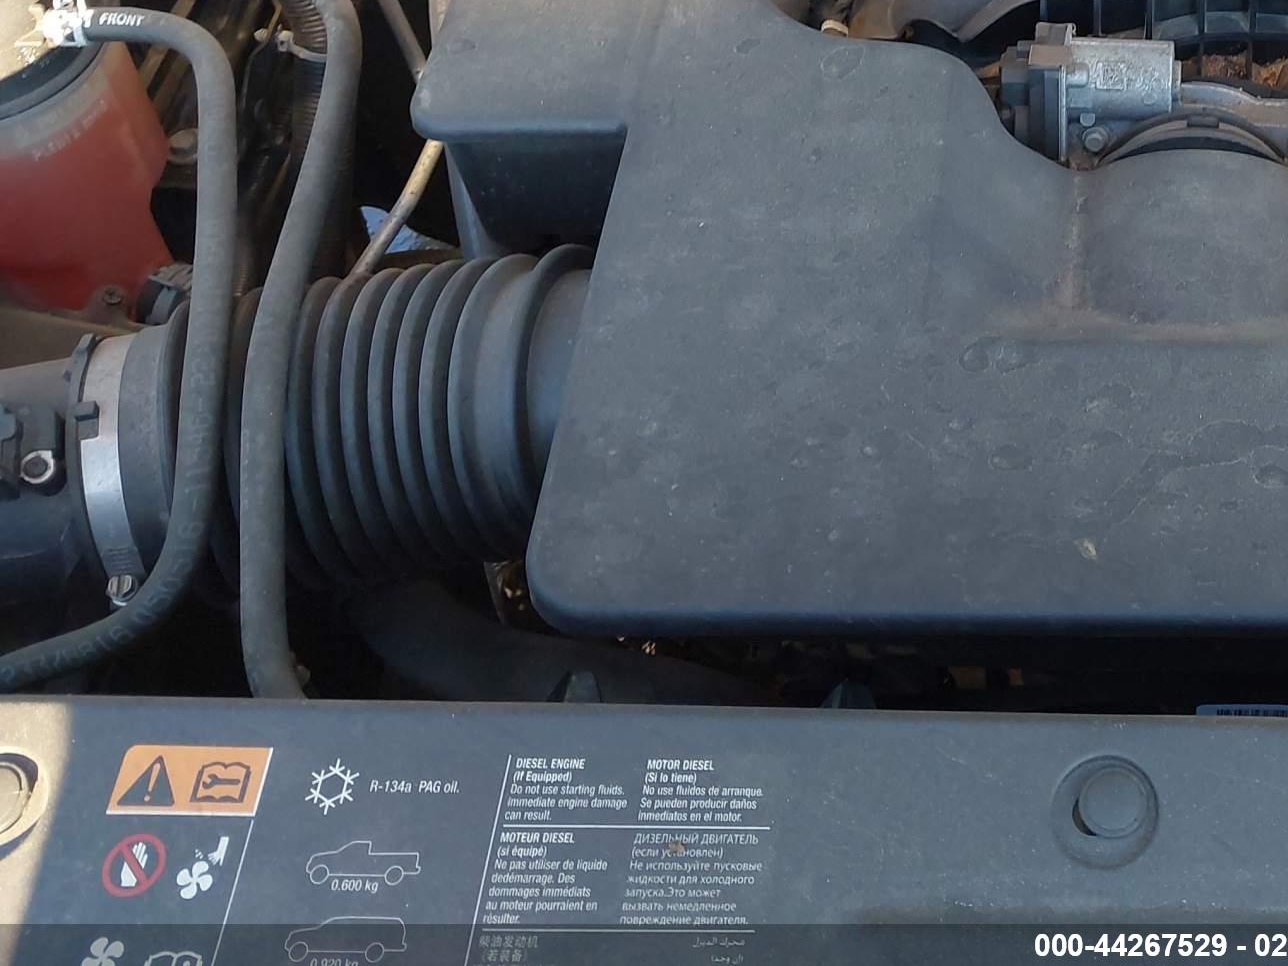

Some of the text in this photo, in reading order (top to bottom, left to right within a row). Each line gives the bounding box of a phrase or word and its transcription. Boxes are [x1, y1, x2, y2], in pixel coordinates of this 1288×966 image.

[99, 14, 146, 27] FRONT
[516, 758, 586, 770] DIESEL ENGINE
[647, 759, 715, 771] MOTOR DIESEL
[513, 771, 572, 784] (If Equipped)
[645, 772, 697, 784] (Si lo tiene)
[369, 779, 460, 793] R-134a PAG oil.
[510, 784, 625, 797] Do not use starting fluids.
[642, 785, 764, 798] No use fluidos de arranque.
[507, 797, 627, 810] Immediate engine damage
[640, 797, 757, 810] Se pueden producir daños
[504, 810, 552, 821] can result.
[690, 813, 702, 822] en
[703, 811, 712, 822] el
[714, 812, 742, 822] motor.
[500, 832, 576, 844] MOTEUR DIESEL
[701, 834, 759, 845] ДВИГАТЕЛЬ
[497, 845, 548, 858] (si équipé)
[631, 847, 659, 858] (если
[494, 859, 608, 872] Ne pas utiliser de liquide
[629, 860, 762, 872] Не используйте пусковые
[557, 873, 576, 884] Des
[626, 875, 755, 885] жидкости для холодного
[331, 879, 379, 894] 0.600 kg
[488, 886, 592, 899] dommages immédiats
[687, 889, 722, 898] может
[485, 900, 598, 913] au moteur pourraient en
[622, 903, 737, 912] вызвать немедленное
[482, 913, 520, 924] résulter.
[620, 915, 749, 926] повреждение двигателя.
